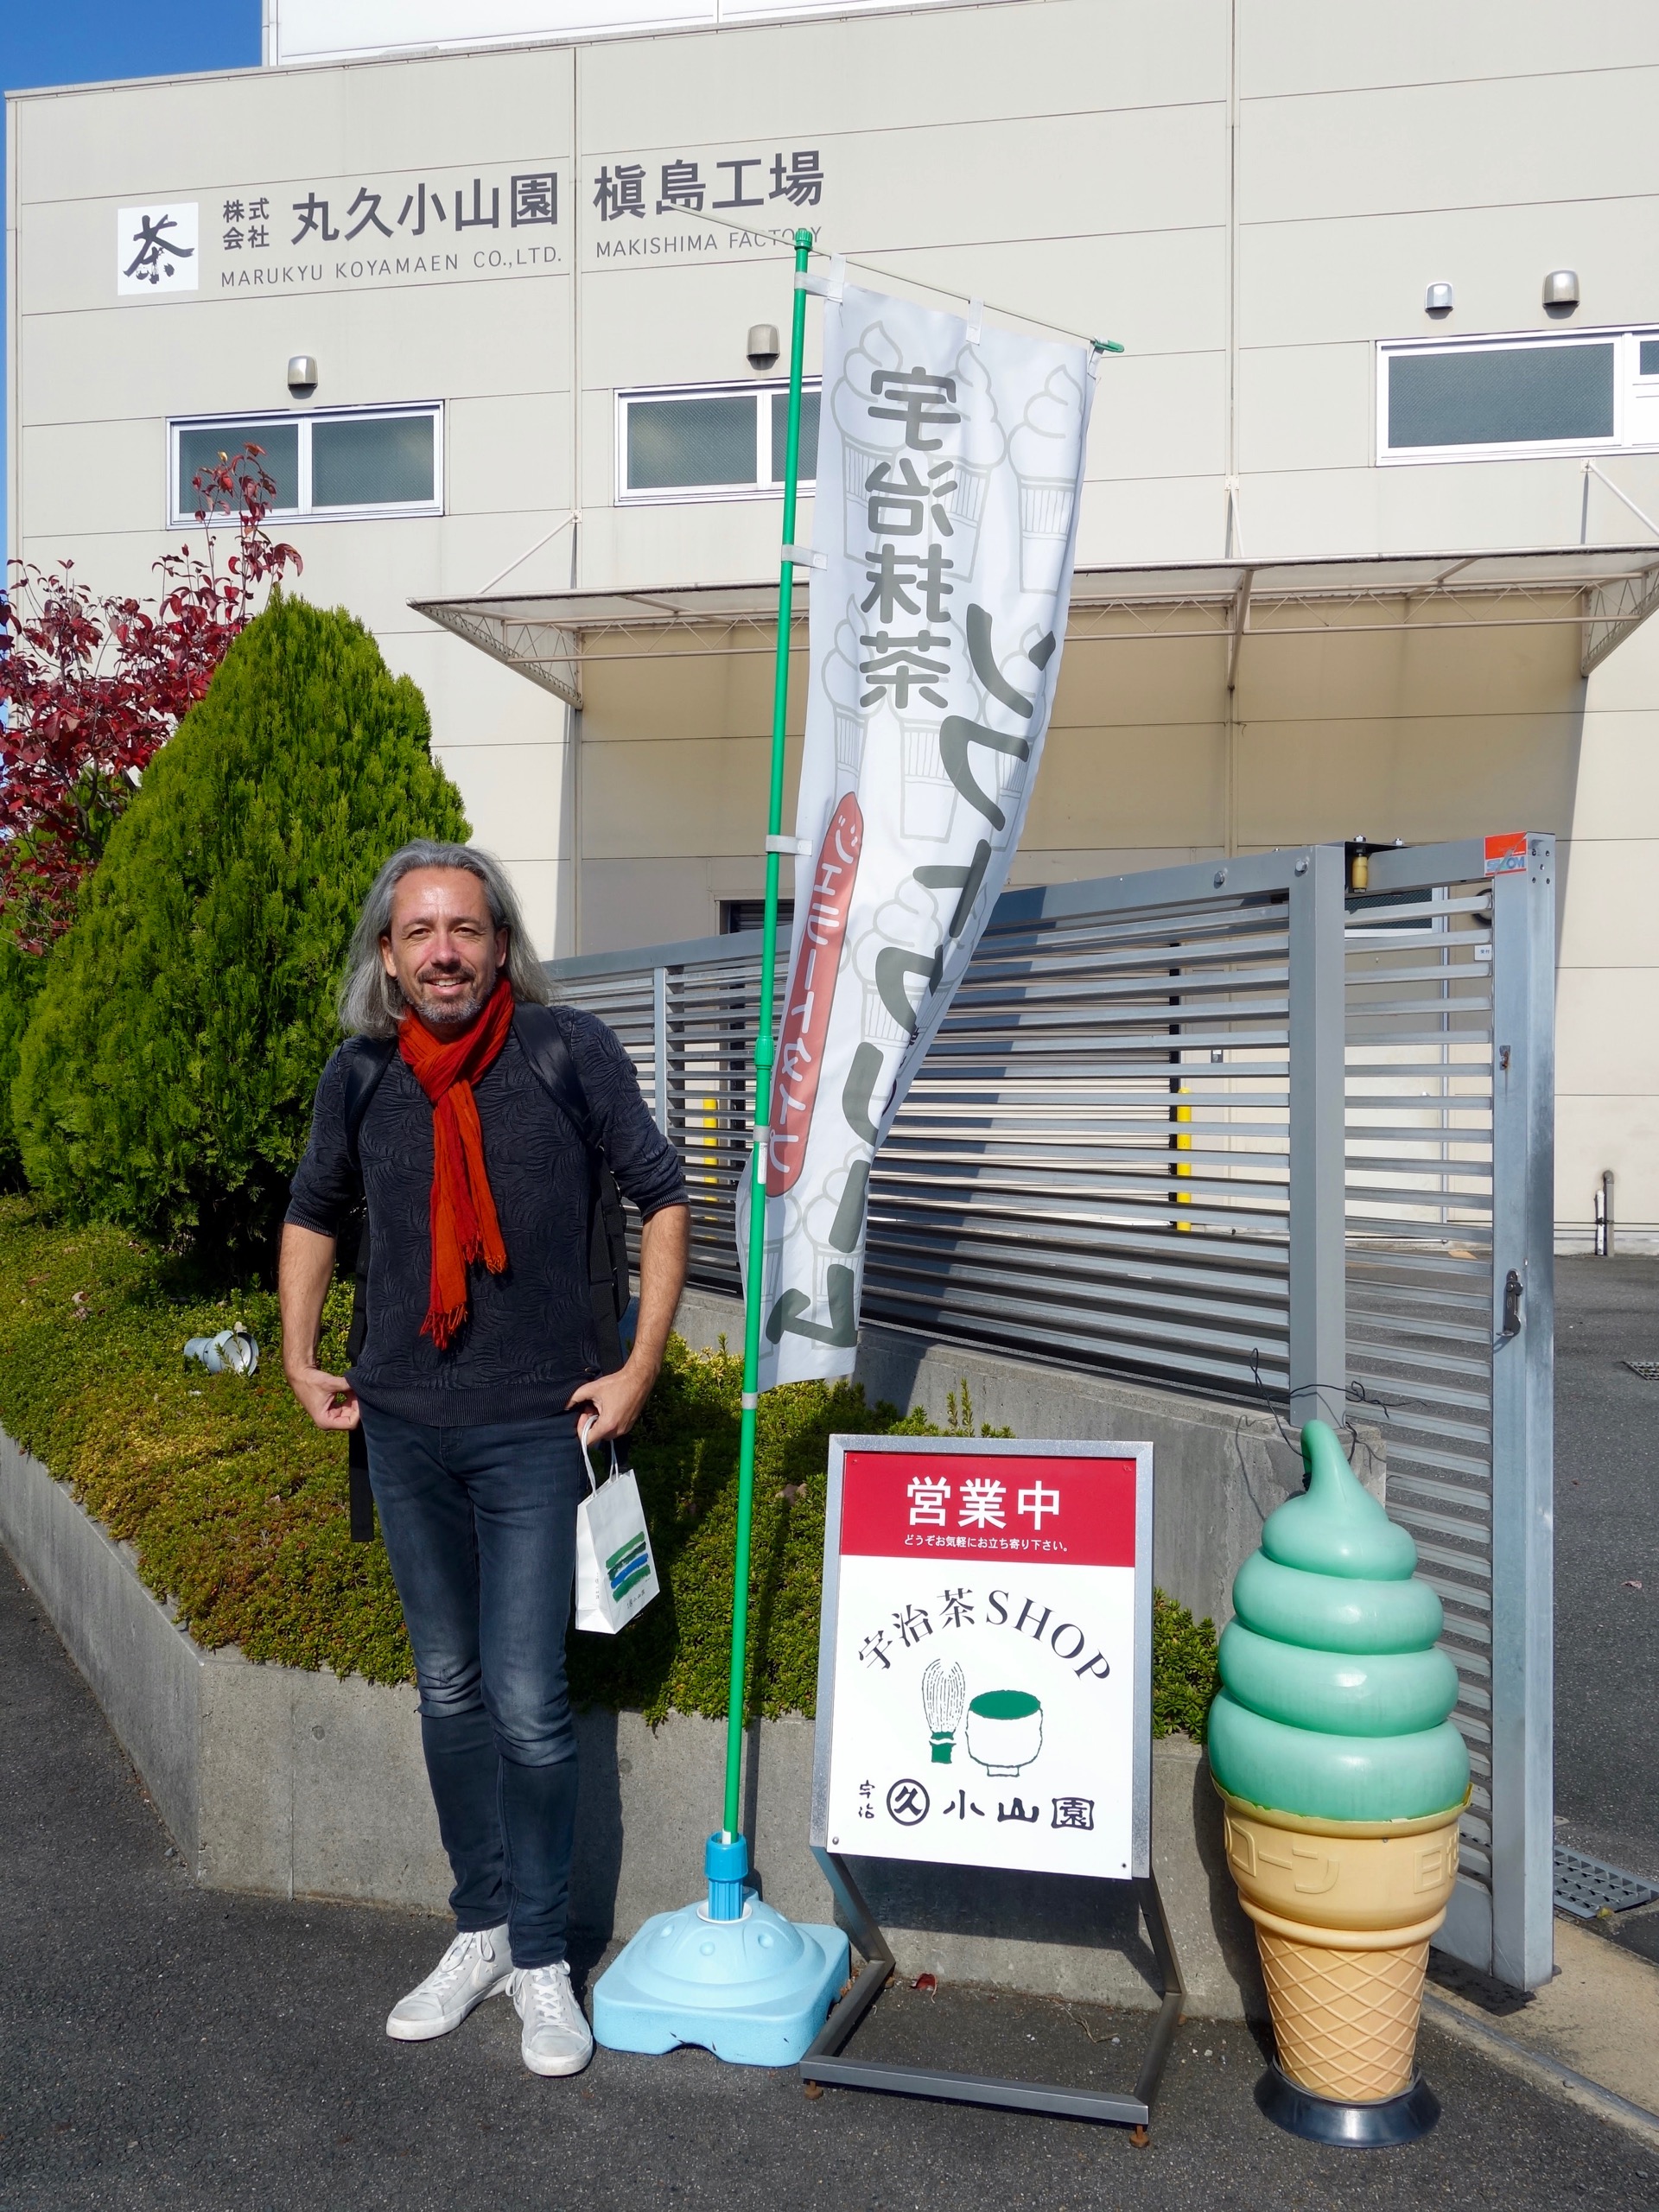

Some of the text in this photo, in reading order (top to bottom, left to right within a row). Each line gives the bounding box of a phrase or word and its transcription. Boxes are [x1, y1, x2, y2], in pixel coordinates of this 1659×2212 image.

[291, 172, 558, 245] 丸久小山園
[221, 264, 323, 288] MARUKYU
[336, 253, 458, 279] KOYAMAEN
[596, 233, 718, 258] MAKISHIMA
[729, 226, 822, 249] FACTOY
[906, 1476, 1061, 1530] 営業中
[904, 1534, 1068, 1553] どうぞお気軽にお立ち寄り下さい。
